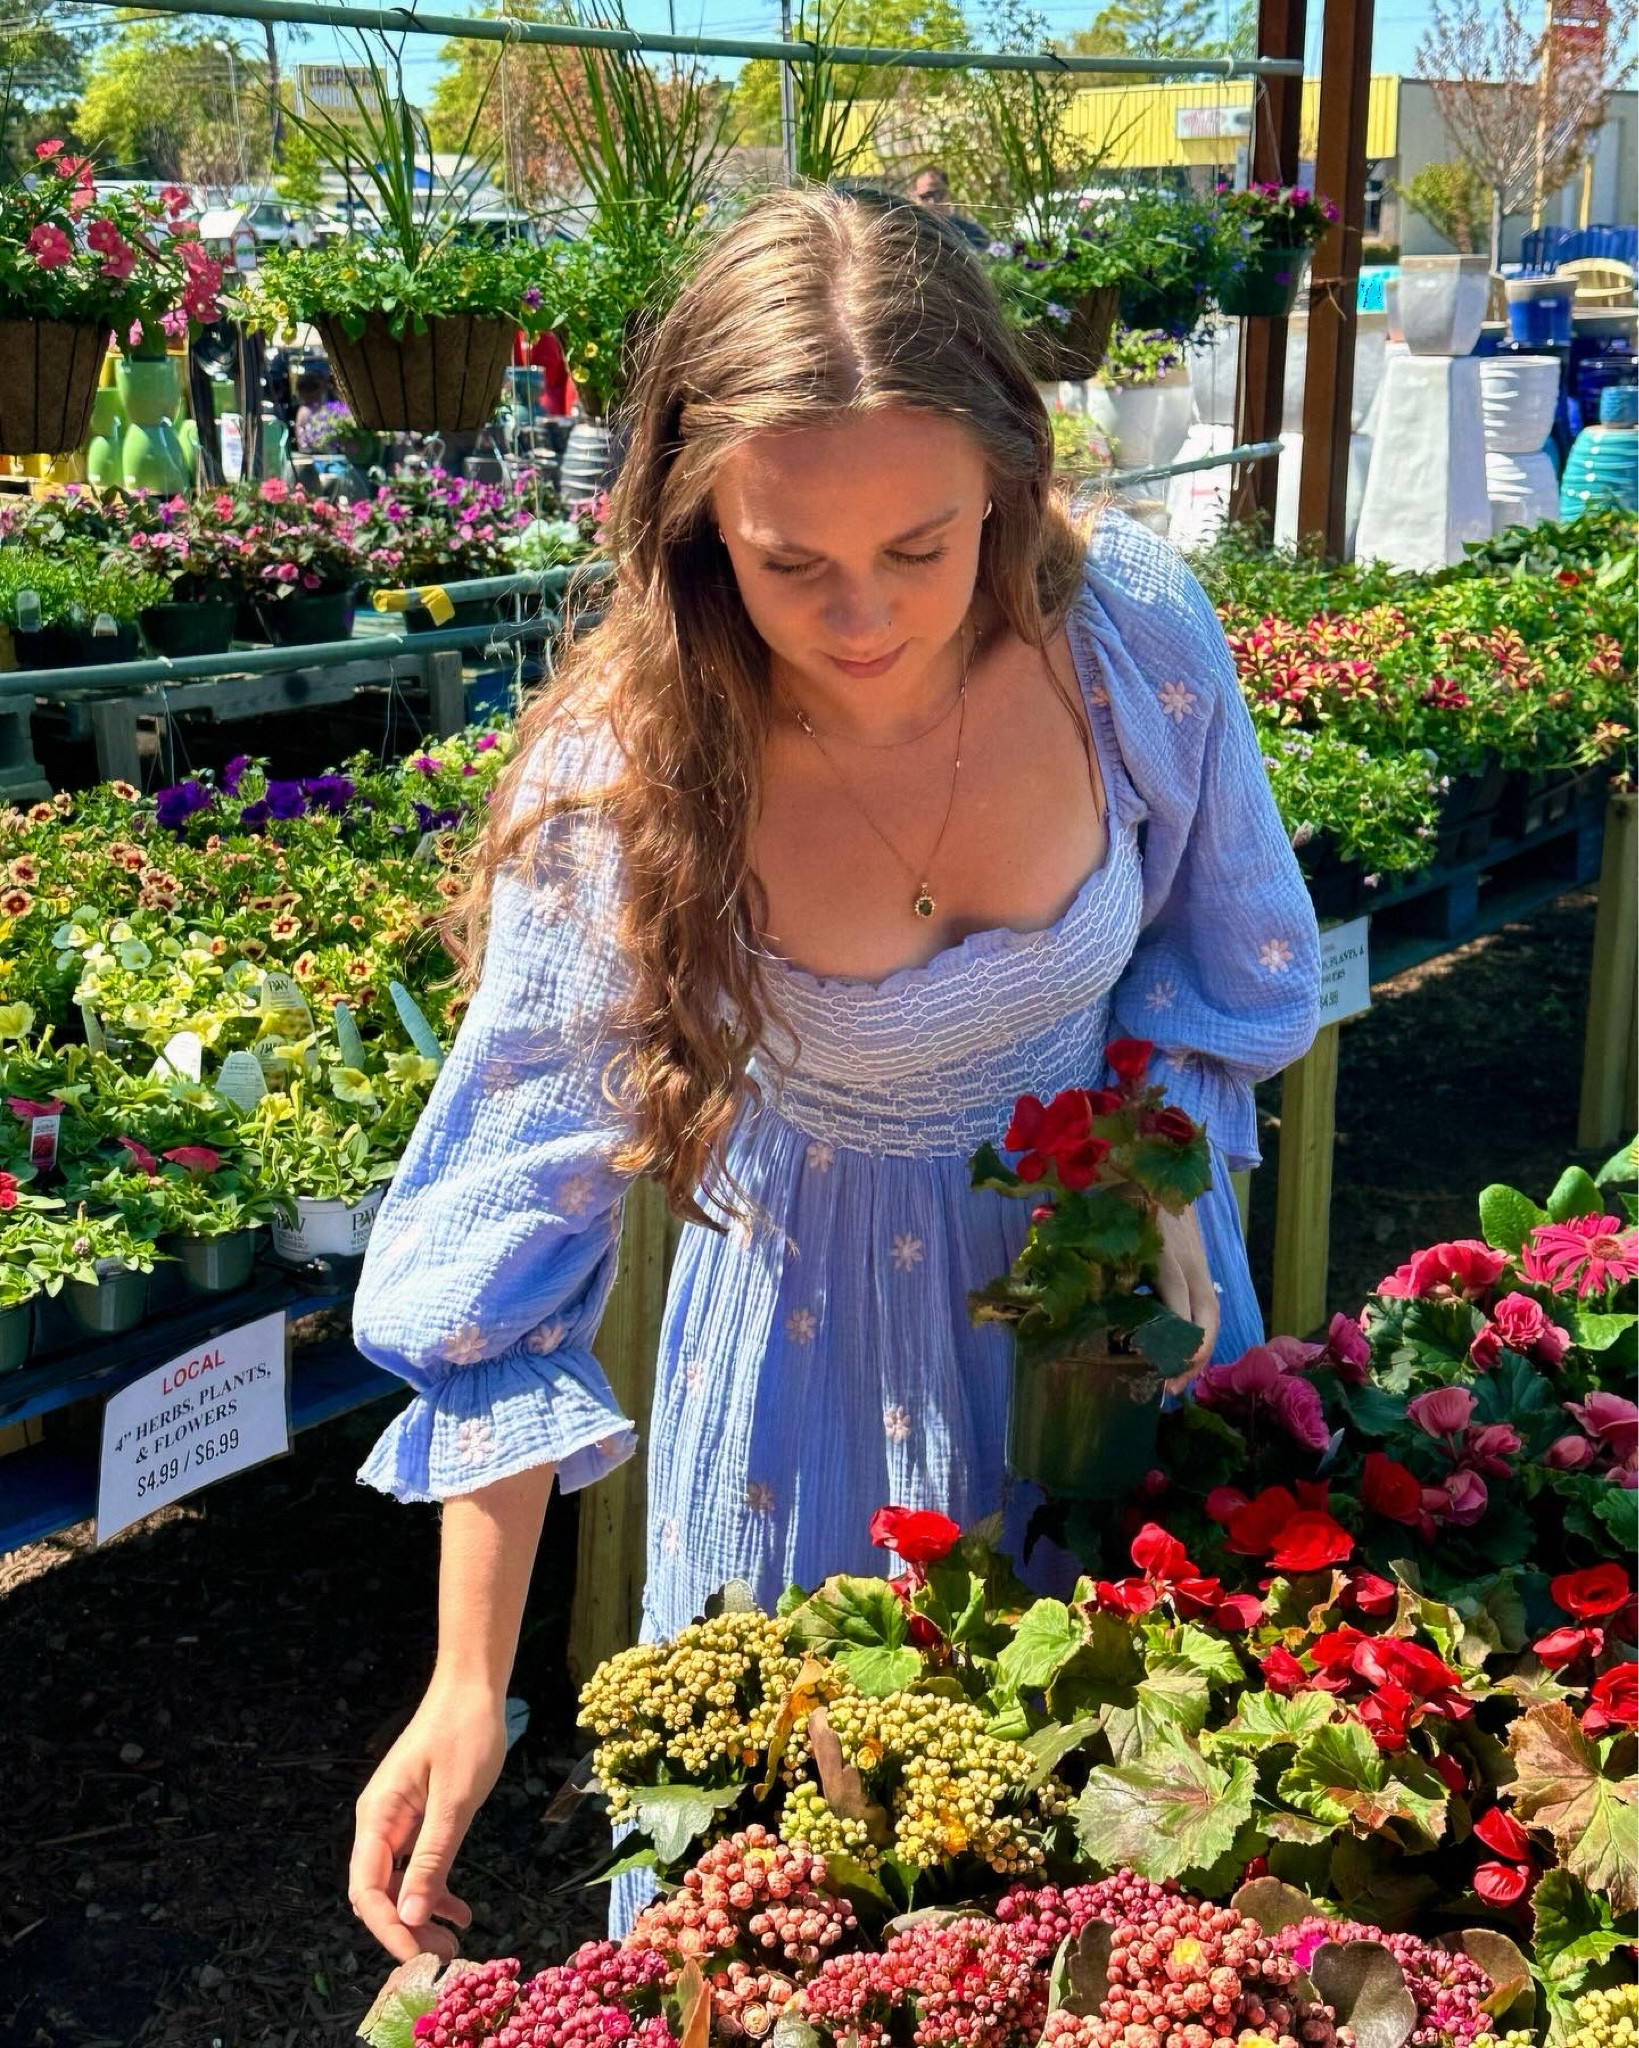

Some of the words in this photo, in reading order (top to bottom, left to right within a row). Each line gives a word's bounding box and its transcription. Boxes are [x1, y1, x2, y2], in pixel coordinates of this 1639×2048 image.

[162, 1349, 226, 1396] LOCAL
[135, 1397, 195, 1442] HERBS,
[135, 1445, 149, 1464] &
[154, 1398, 238, 1455] FLOWERS
[137, 1457, 179, 1498] $4.99
[183, 1449, 191, 1473] /
[195, 1428, 240, 1467] $6.99
